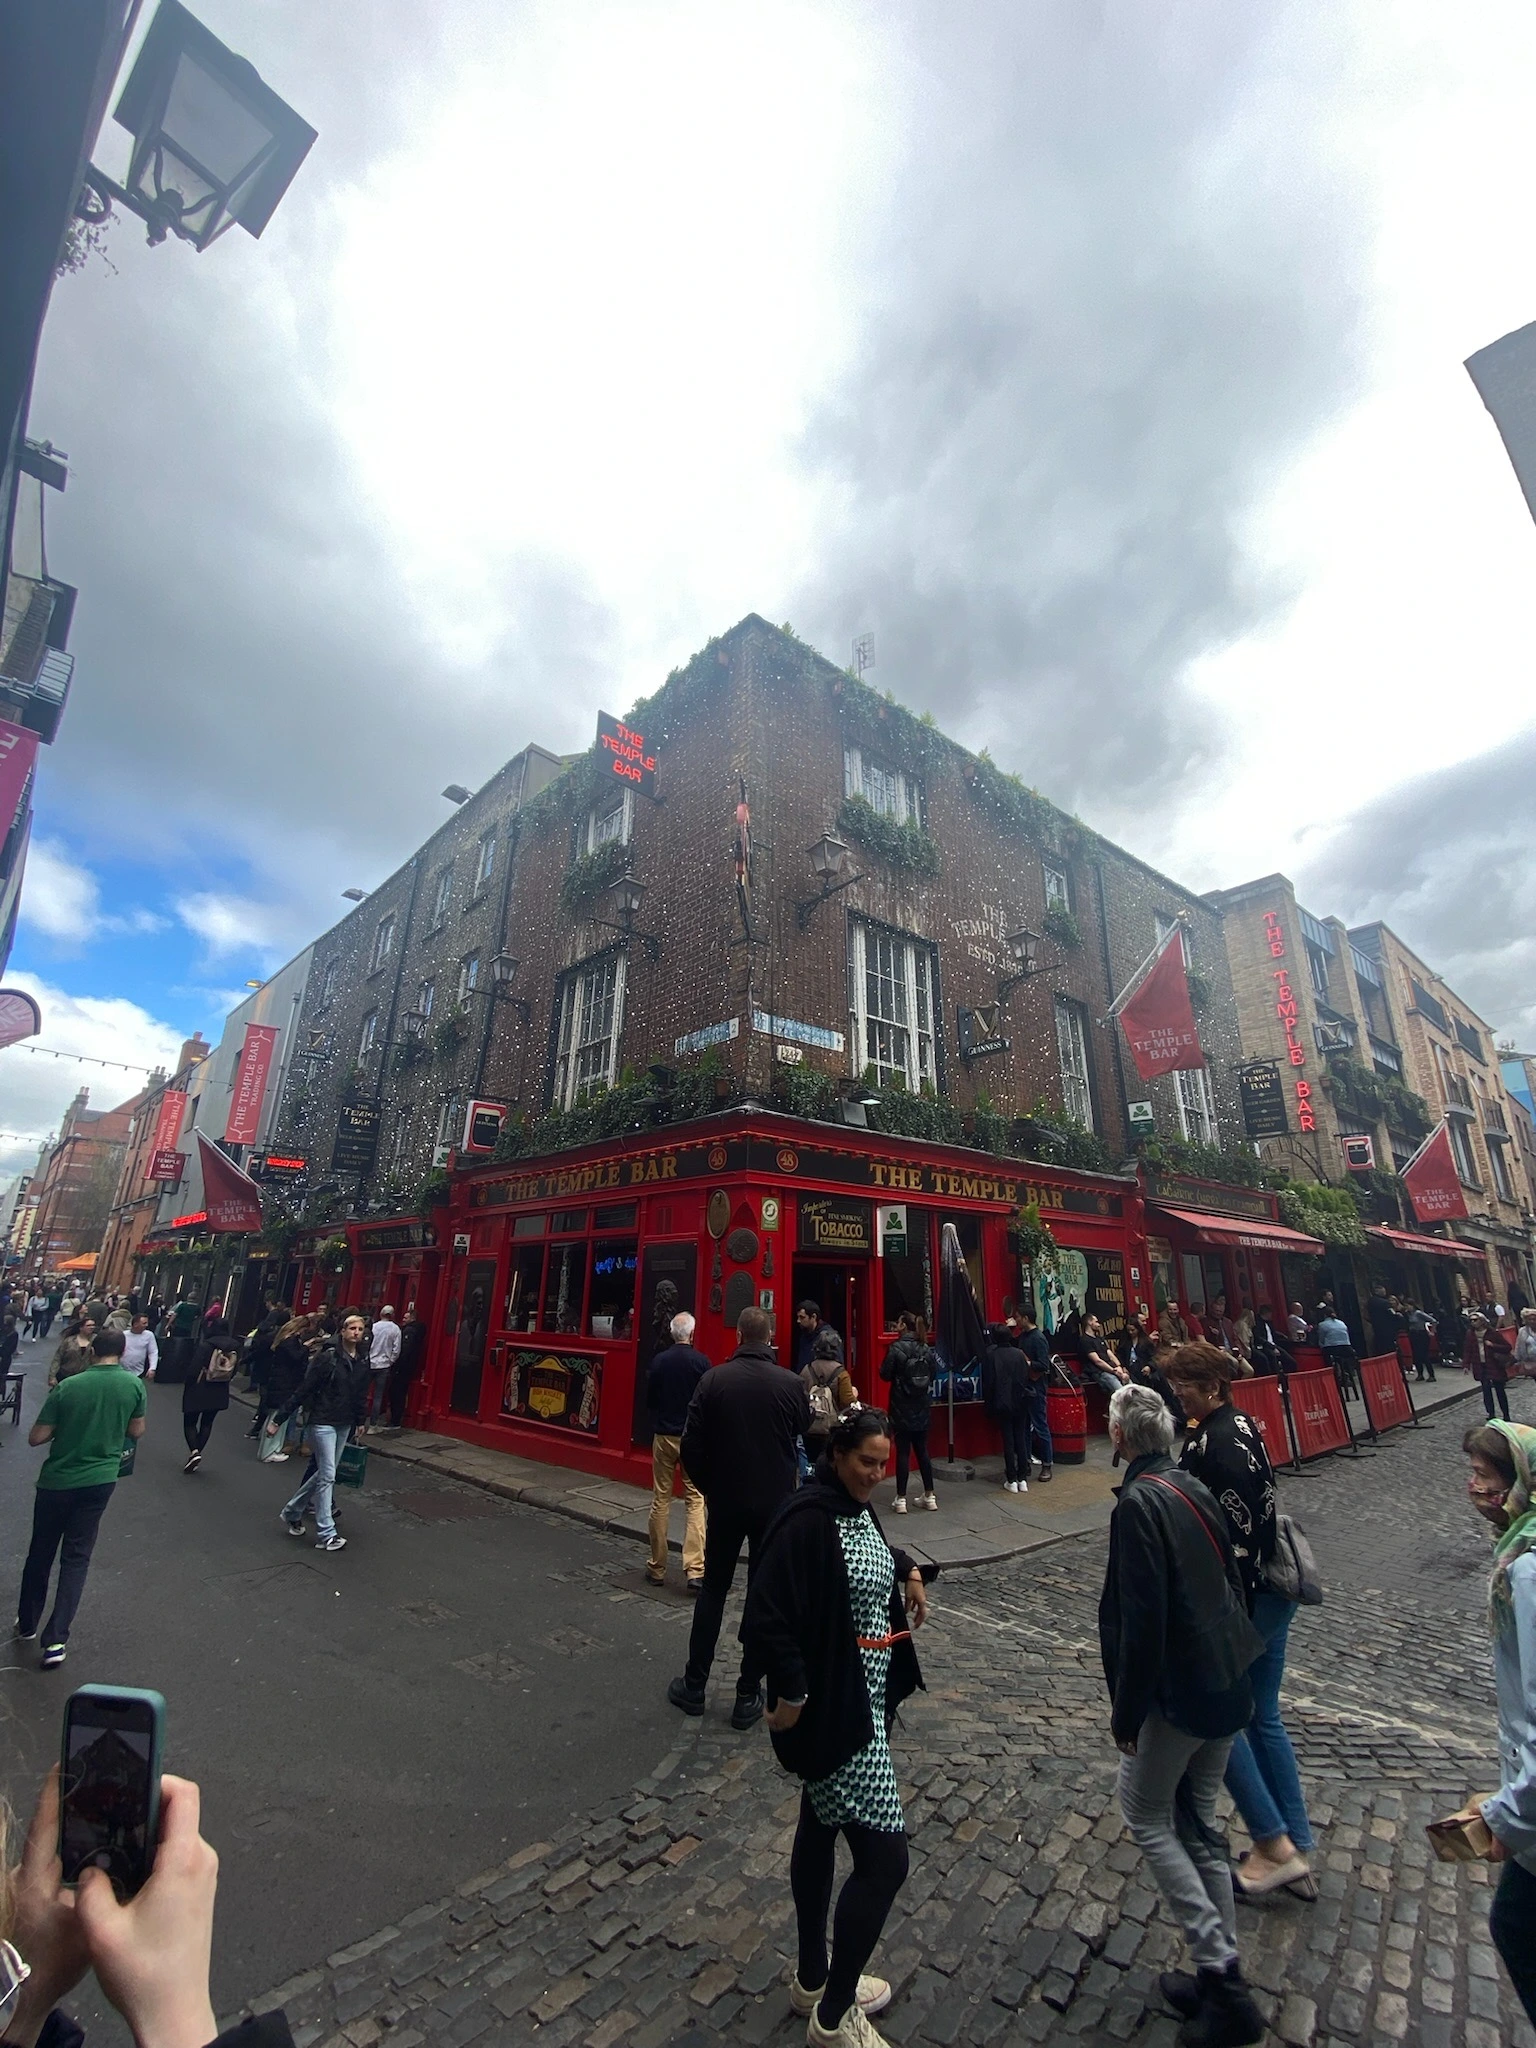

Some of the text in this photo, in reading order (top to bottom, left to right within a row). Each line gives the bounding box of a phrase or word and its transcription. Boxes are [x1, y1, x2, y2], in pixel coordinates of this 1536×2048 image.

[616, 723, 643, 749] THE
[601, 734, 655, 771] TEMPLE
[613, 759, 642, 783] BAR
[981, 901, 1008, 927] THE
[951, 919, 1007, 943] TEMPLE
[1262, 911, 1316, 1133] THE TEMPLE BAR
[1148, 1027, 1174, 1038] THE
[968, 1041, 1002, 1055] GUINNESS
[1134, 1033, 1193, 1052] TEMPLE
[1150, 1047, 1178, 1060] BAR
[234, 1041, 260, 1127] THE TEMPLE BAR
[1242, 1073, 1278, 1083] TEMPLE
[250, 1074, 262, 1106] TRADING
[1250, 1082, 1271, 1091] BAR
[343, 1107, 380, 1119] TEMPLE
[350, 1117, 370, 1126] BAR
[505, 1179, 539, 1201] THE
[545, 1165, 620, 1196] TEMPLE
[630, 1156, 678, 1183] BAR
[710, 1151, 724, 1166] 48
[780, 1152, 794, 1167] 48
[870, 1163, 923, 1190] THE
[931, 1172, 1018, 1203] TEMPLE
[1026, 1186, 1065, 1209] BAR
[1414, 1192, 1459, 1204] TEMPLE
[1425, 1188, 1444, 1196] THE
[208, 1205, 256, 1216] TEMPLE
[1427, 1201, 1451, 1210] BAR
[221, 1214, 245, 1223] BAR
[839, 1214, 863, 1222] SMOKING
[810, 1215, 864, 1241] TOBACCO
[1239, 1236, 1250, 1246] THE
[1251, 1237, 1271, 1248] TEMPLE
[1271, 1239, 1282, 1249] BAR
[1062, 1254, 1077, 1264] THE
[1064, 1275, 1079, 1285] BAR
[1109, 1274, 1122, 1287] THE
[1095, 1287, 1125, 1302] EMPEROR
